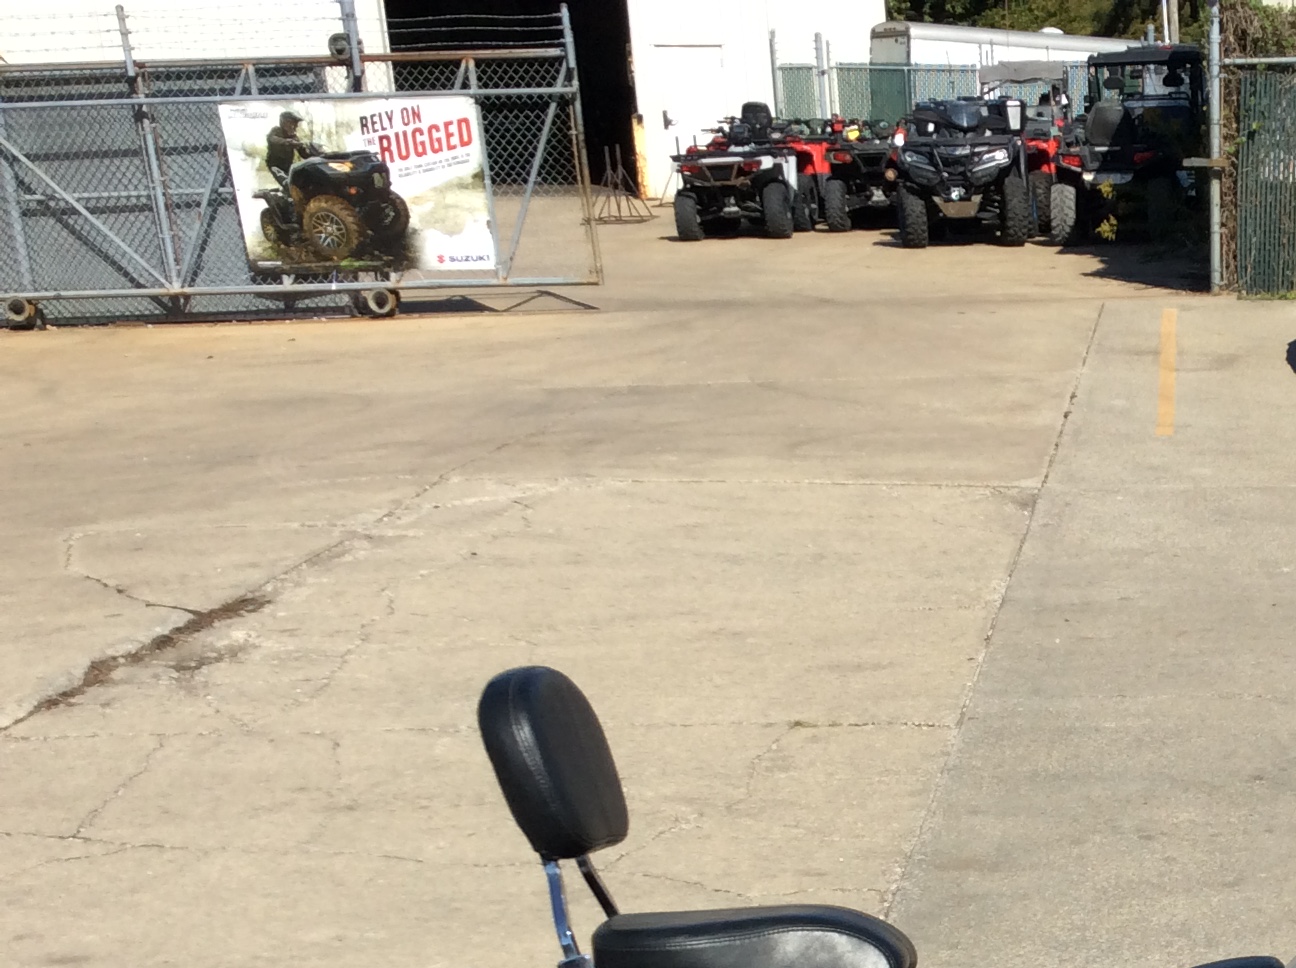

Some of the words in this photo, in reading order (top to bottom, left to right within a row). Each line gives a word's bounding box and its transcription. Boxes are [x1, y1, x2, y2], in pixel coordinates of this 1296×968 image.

[359, 110, 393, 135] RELY
[401, 105, 422, 126] ON
[363, 137, 376, 147] THE
[378, 117, 473, 163] RUGGED
[448, 254, 490, 263] SUZUKI
